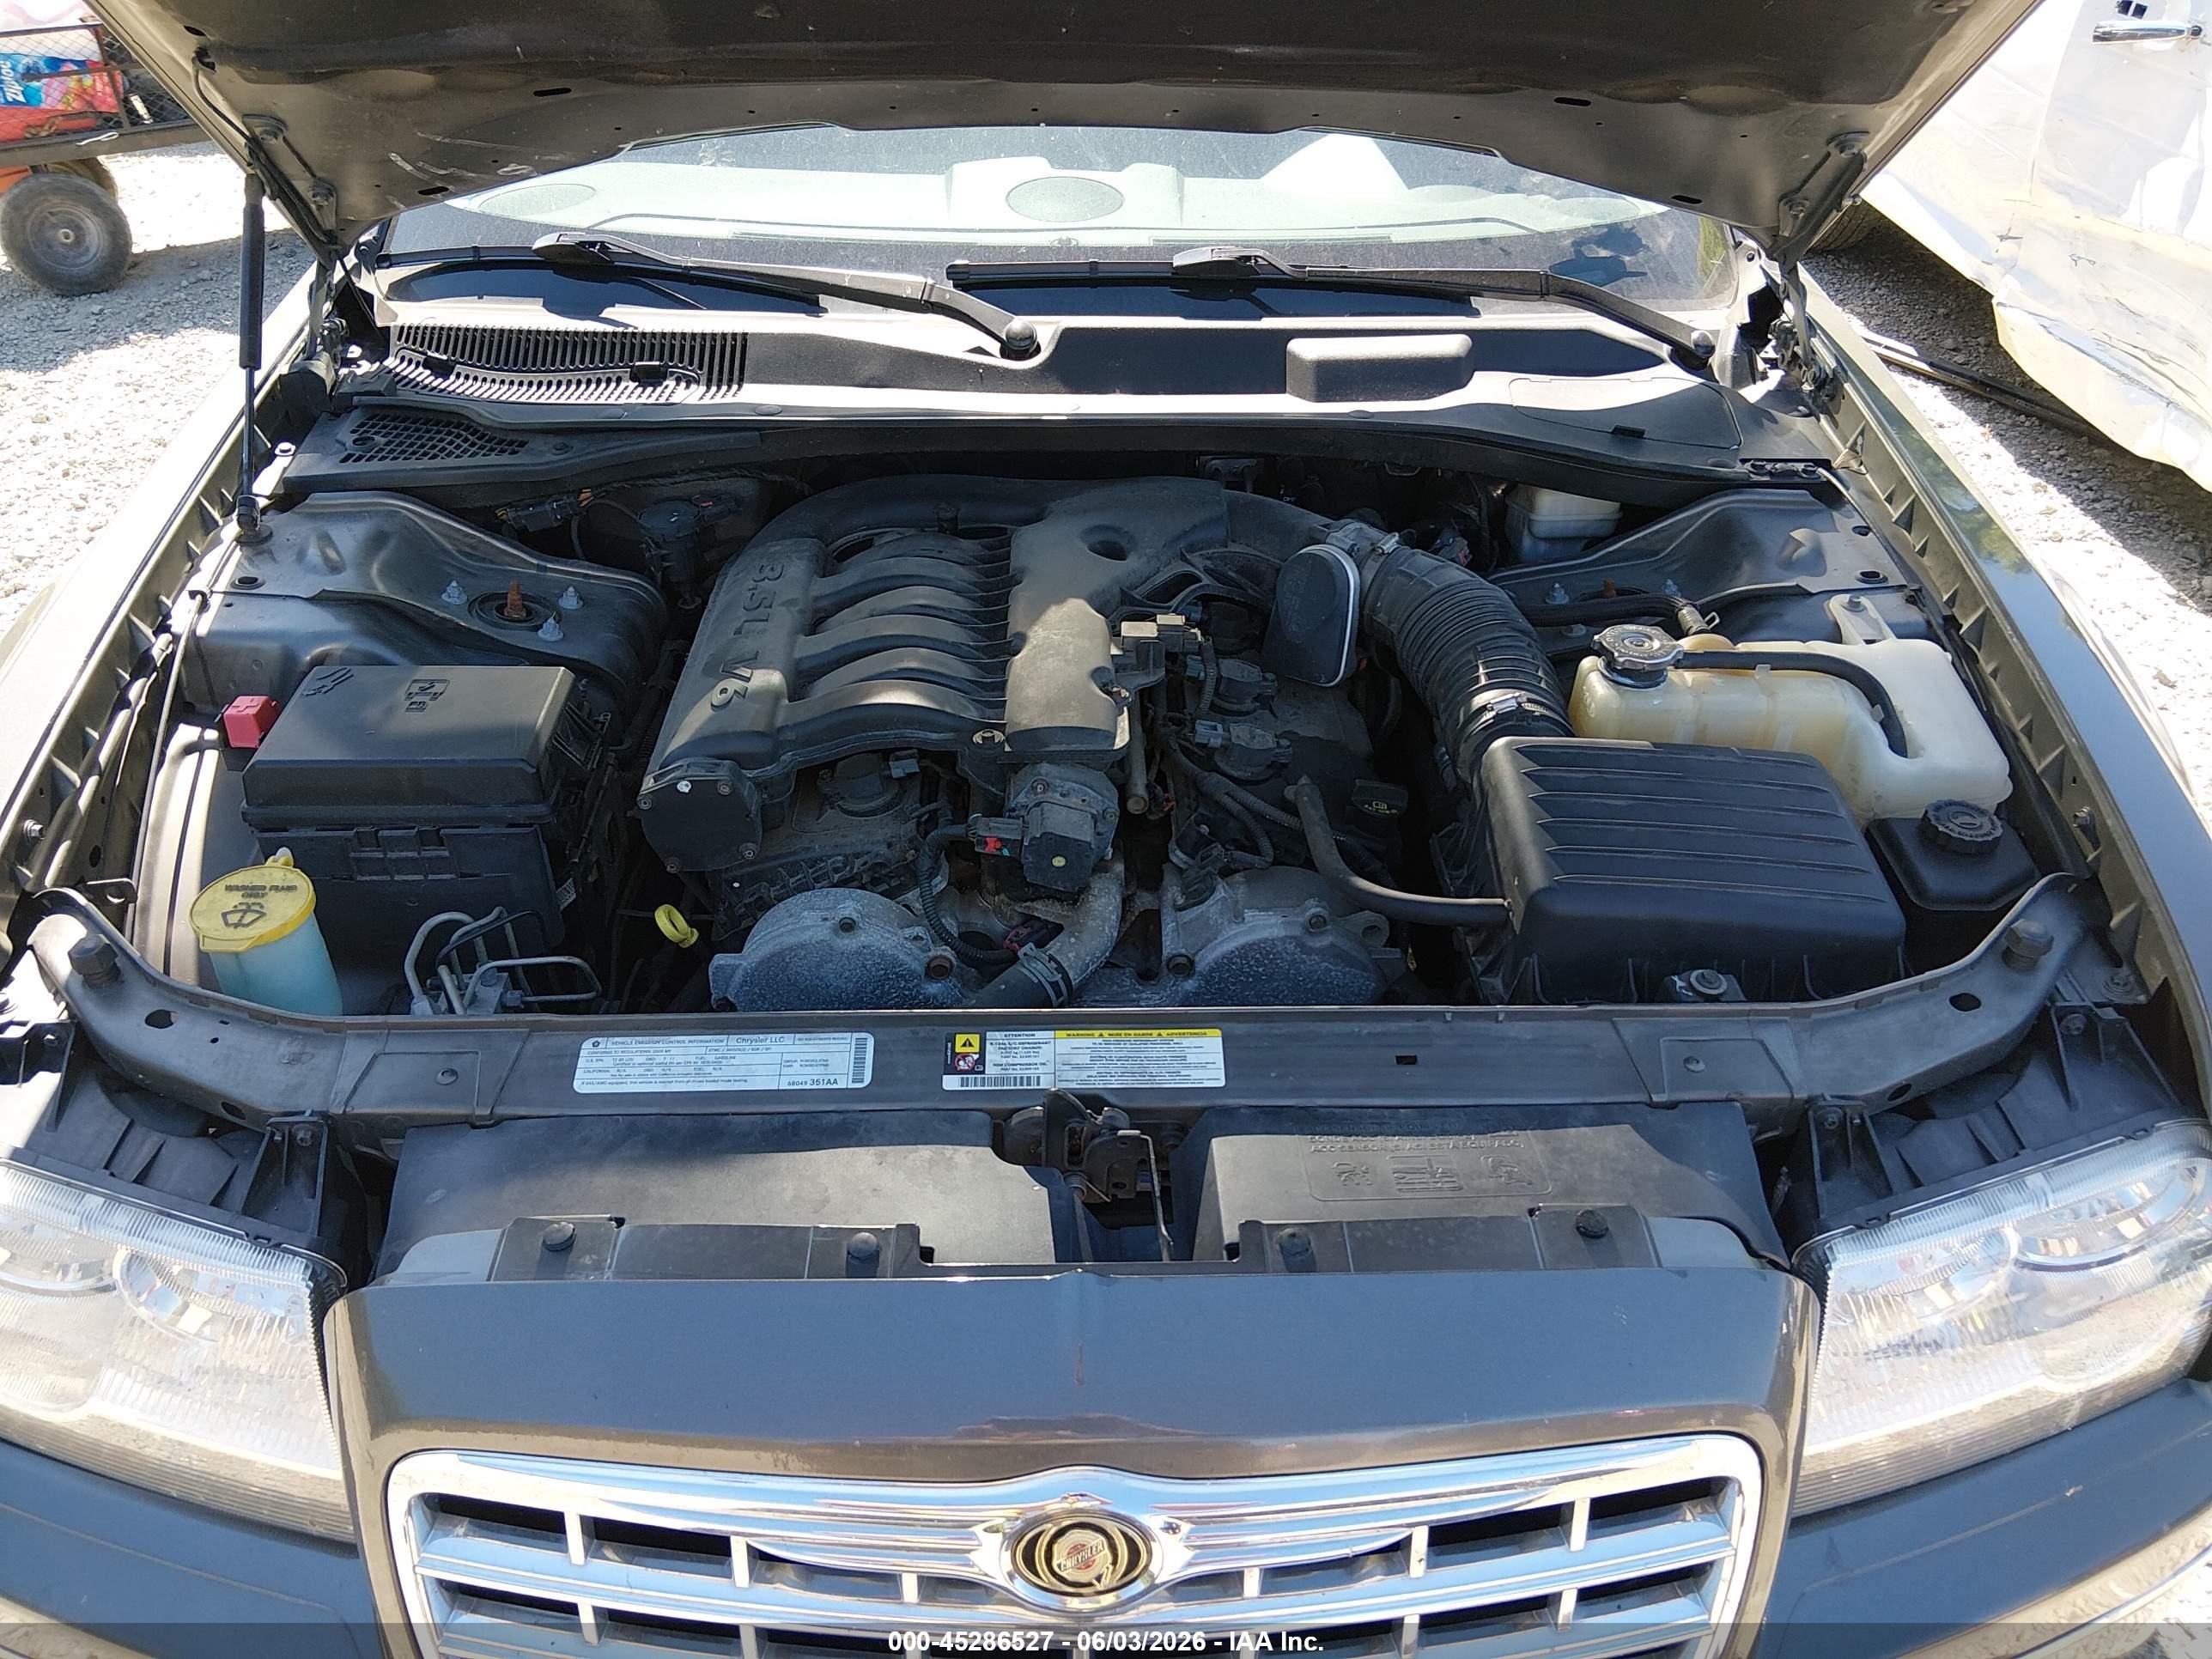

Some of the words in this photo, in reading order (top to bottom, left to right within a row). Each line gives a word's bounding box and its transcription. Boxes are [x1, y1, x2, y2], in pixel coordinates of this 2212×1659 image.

[734, 562, 787, 637] 3.5L
[711, 650, 759, 713] V6
[736, 1036, 769, 1046] Chrysler
